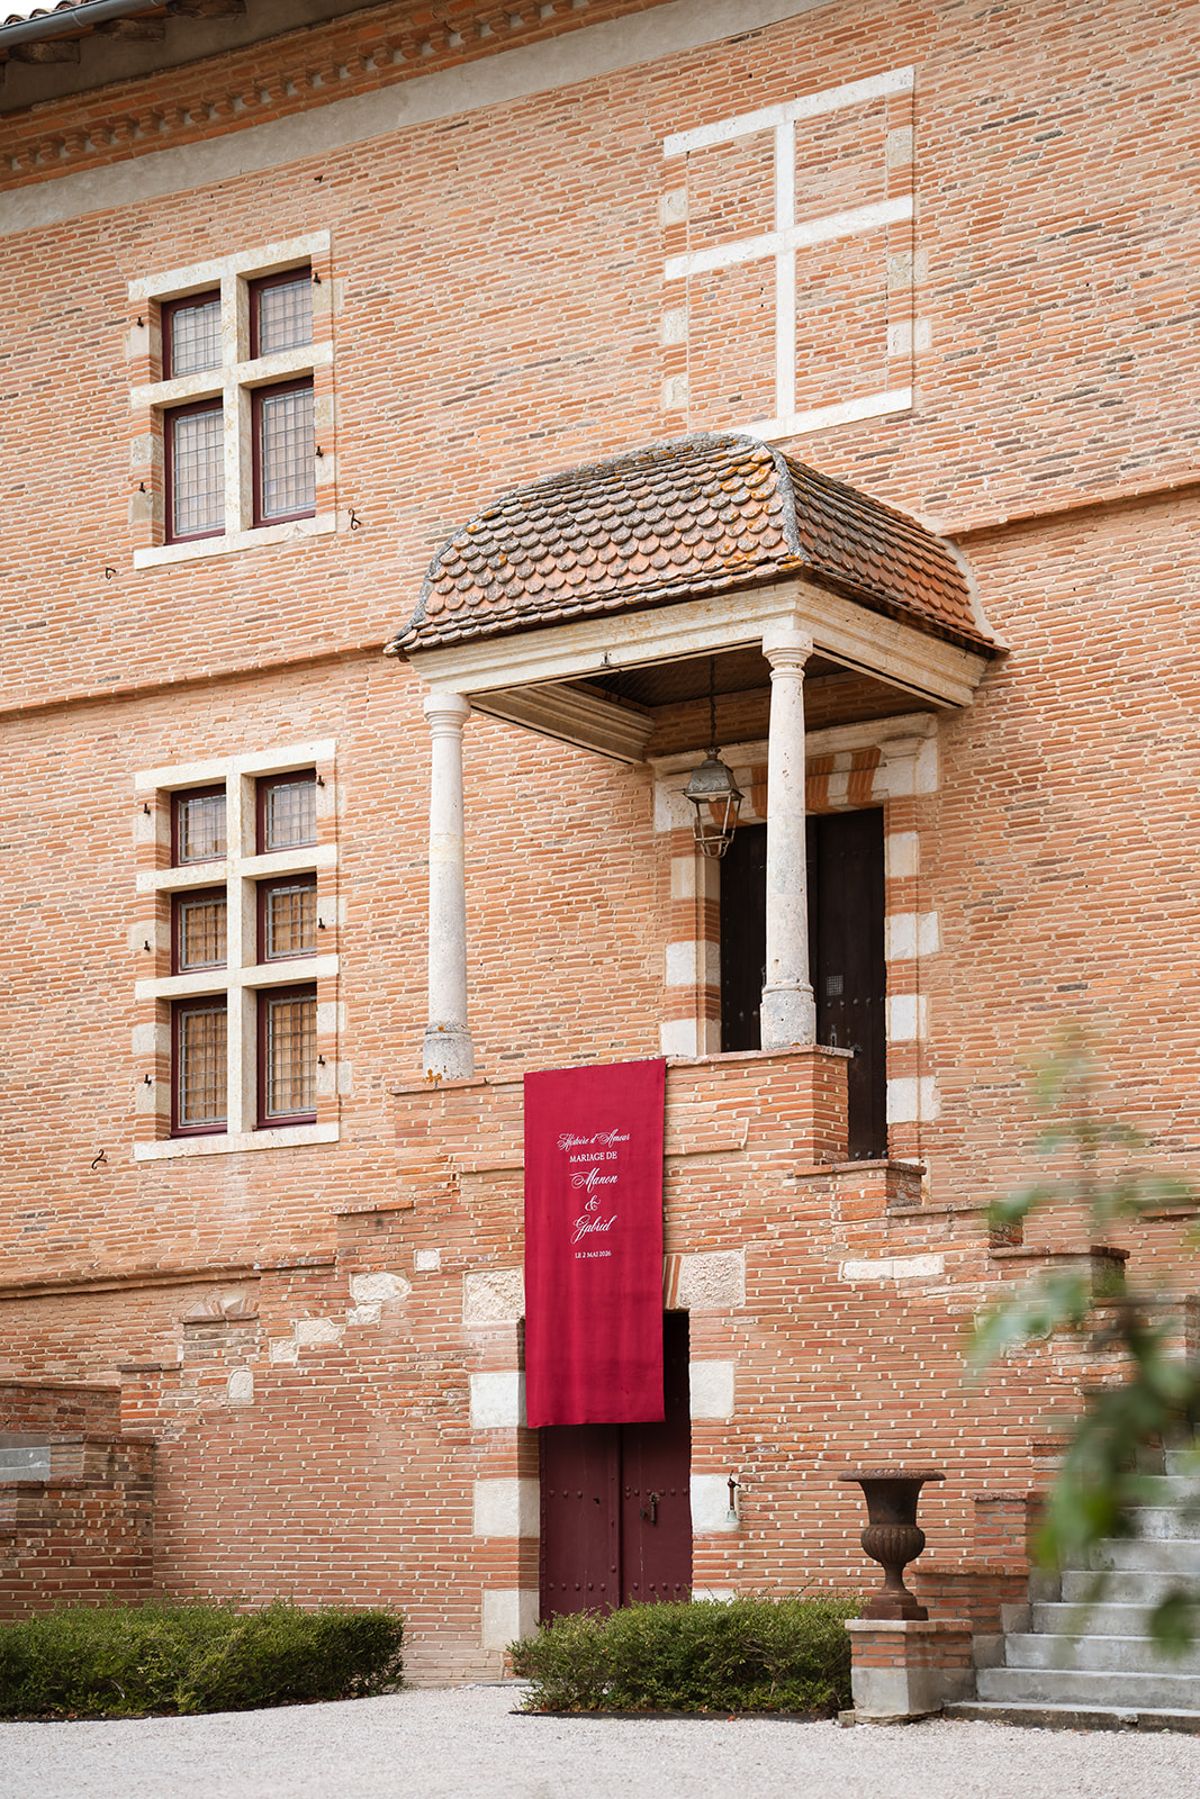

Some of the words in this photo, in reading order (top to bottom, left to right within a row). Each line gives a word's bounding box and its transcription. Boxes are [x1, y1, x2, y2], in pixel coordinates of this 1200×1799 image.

[557, 1133, 589, 1151] Histoire
[569, 1151, 605, 1163] MARIAGE
[606, 1151, 618, 1160] DE
[569, 1167, 619, 1194] Manon
[584, 1195, 601, 1212] &
[570, 1214, 618, 1244] Gabriel
